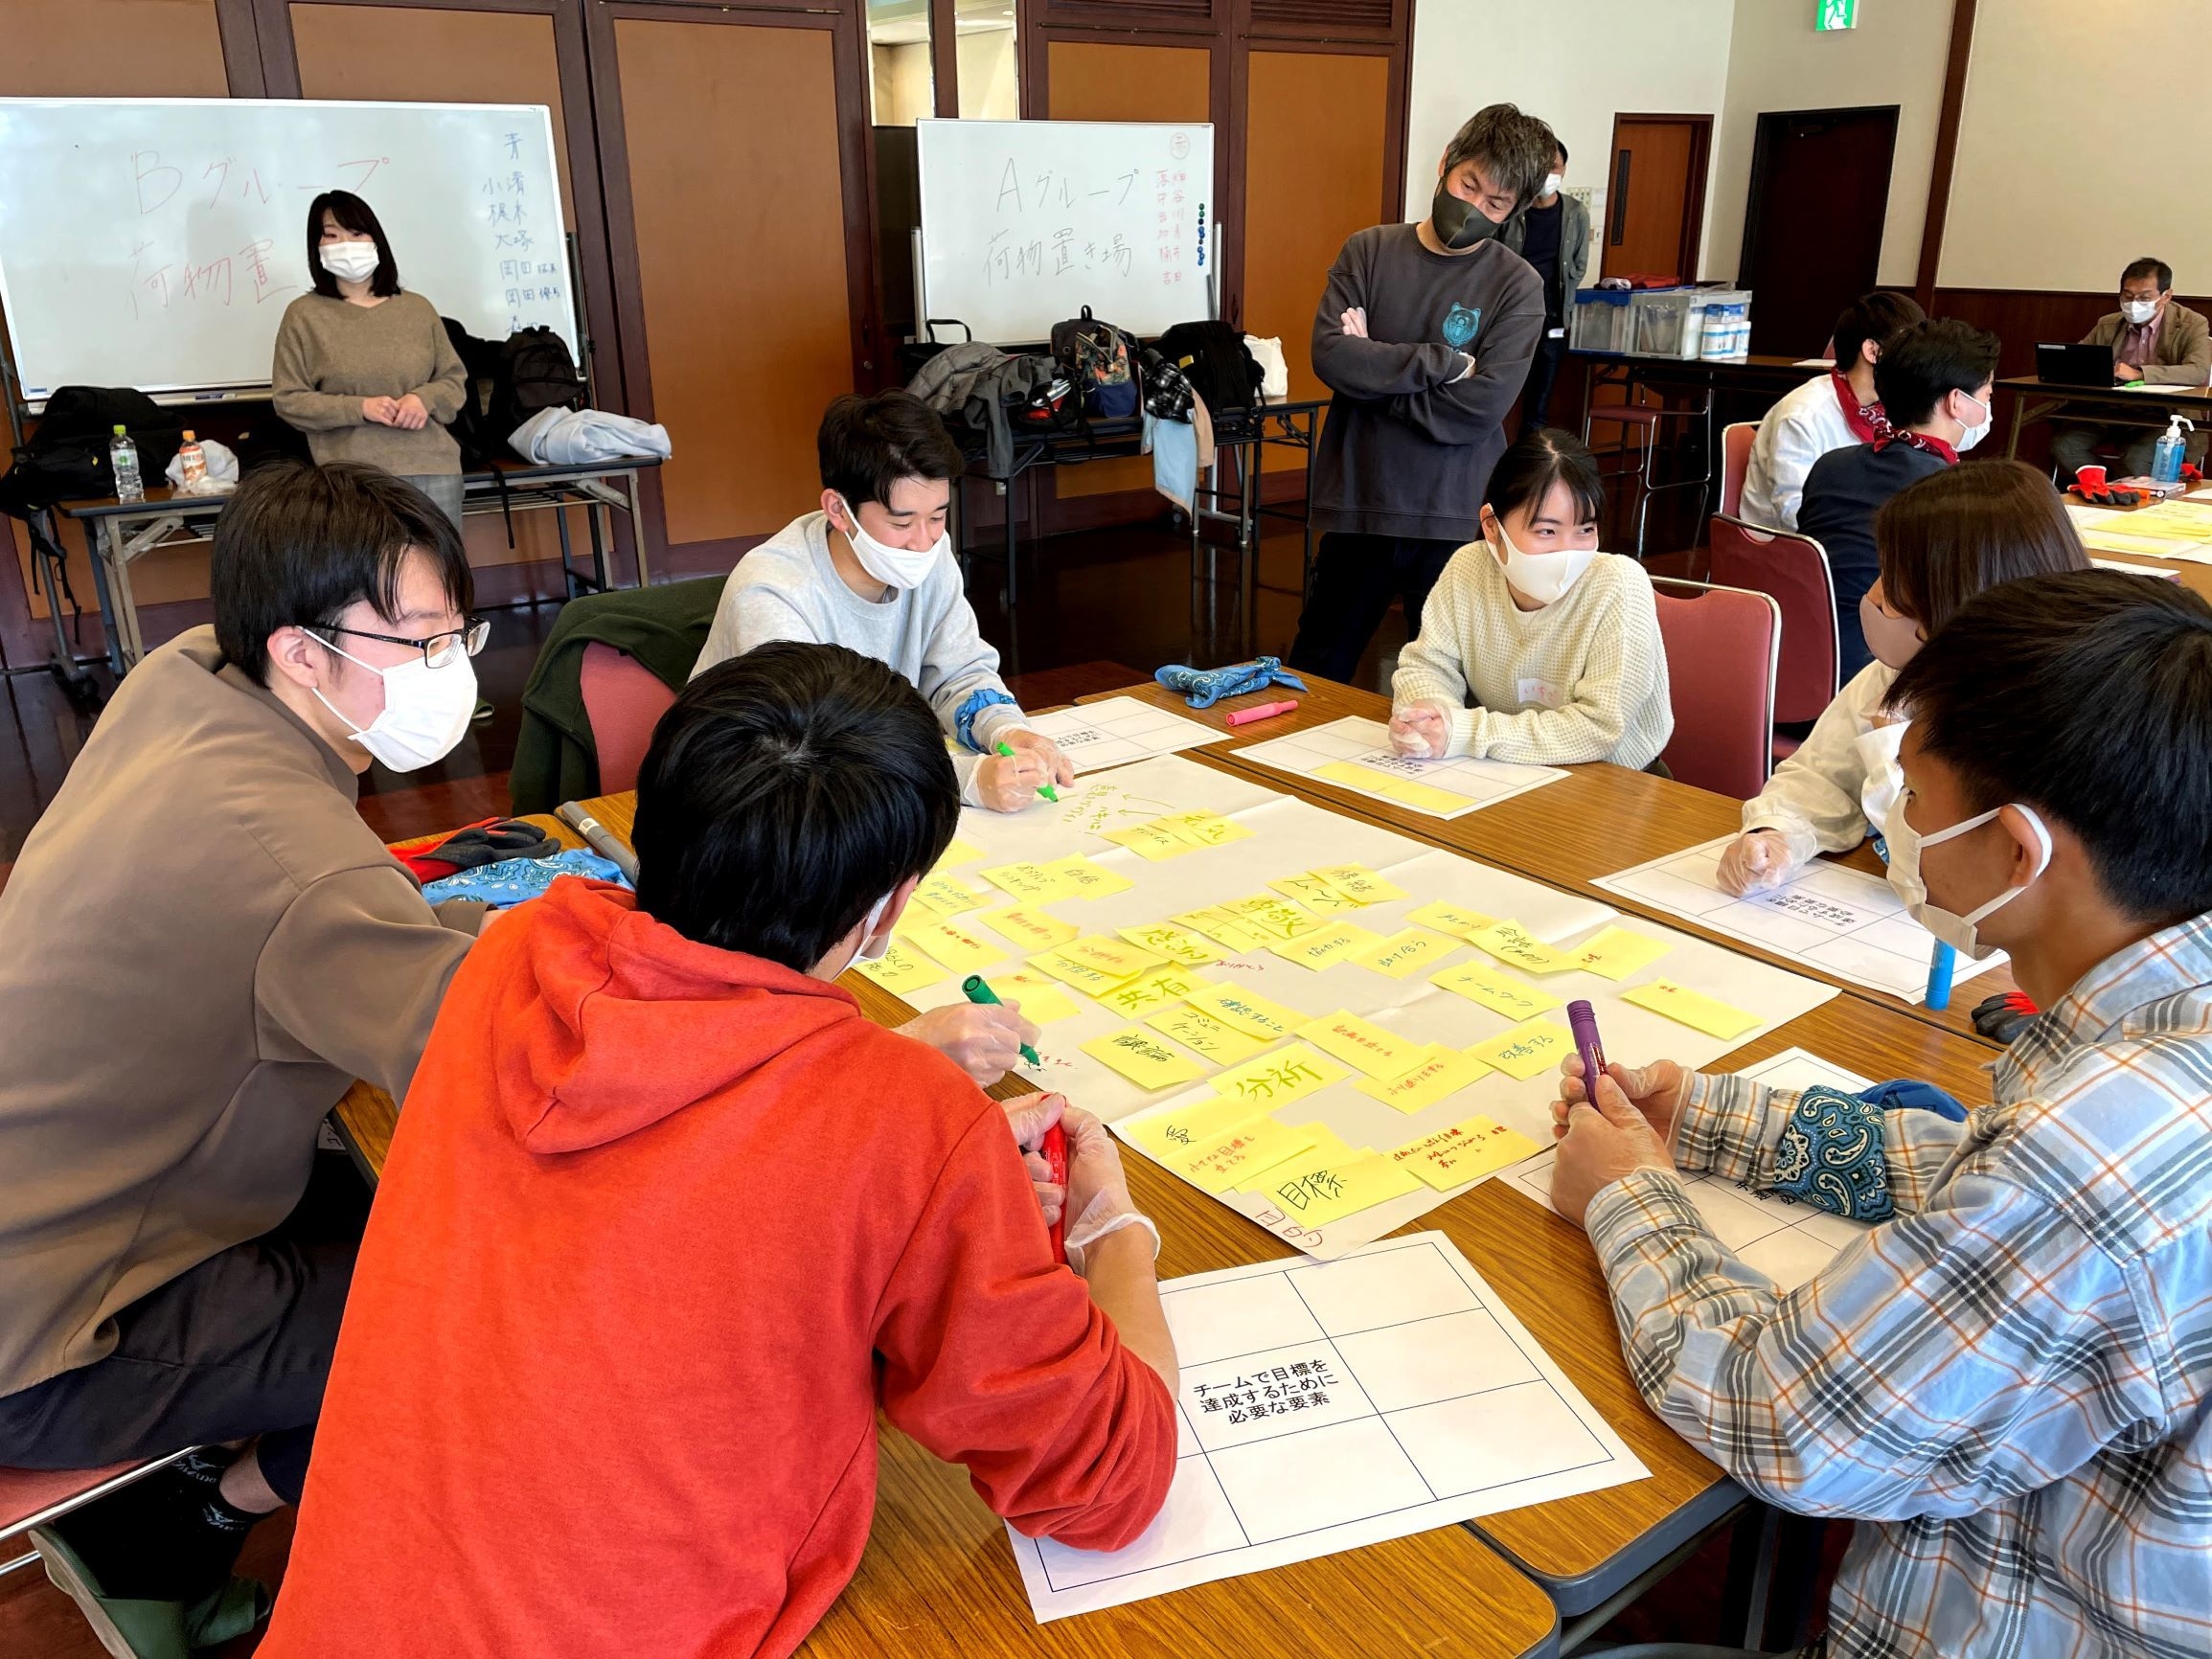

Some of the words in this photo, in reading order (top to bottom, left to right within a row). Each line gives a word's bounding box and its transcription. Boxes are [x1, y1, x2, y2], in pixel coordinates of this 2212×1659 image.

[1116, 976, 1191, 1010] 共有
[1237, 1059, 1323, 1102] 分析
[1276, 1170, 1348, 1211] 目標
[1194, 1358, 1329, 1398] チームで目標を
[1200, 1374, 1339, 1414] 達成するために
[1228, 1391, 1332, 1424] 必要な要素
